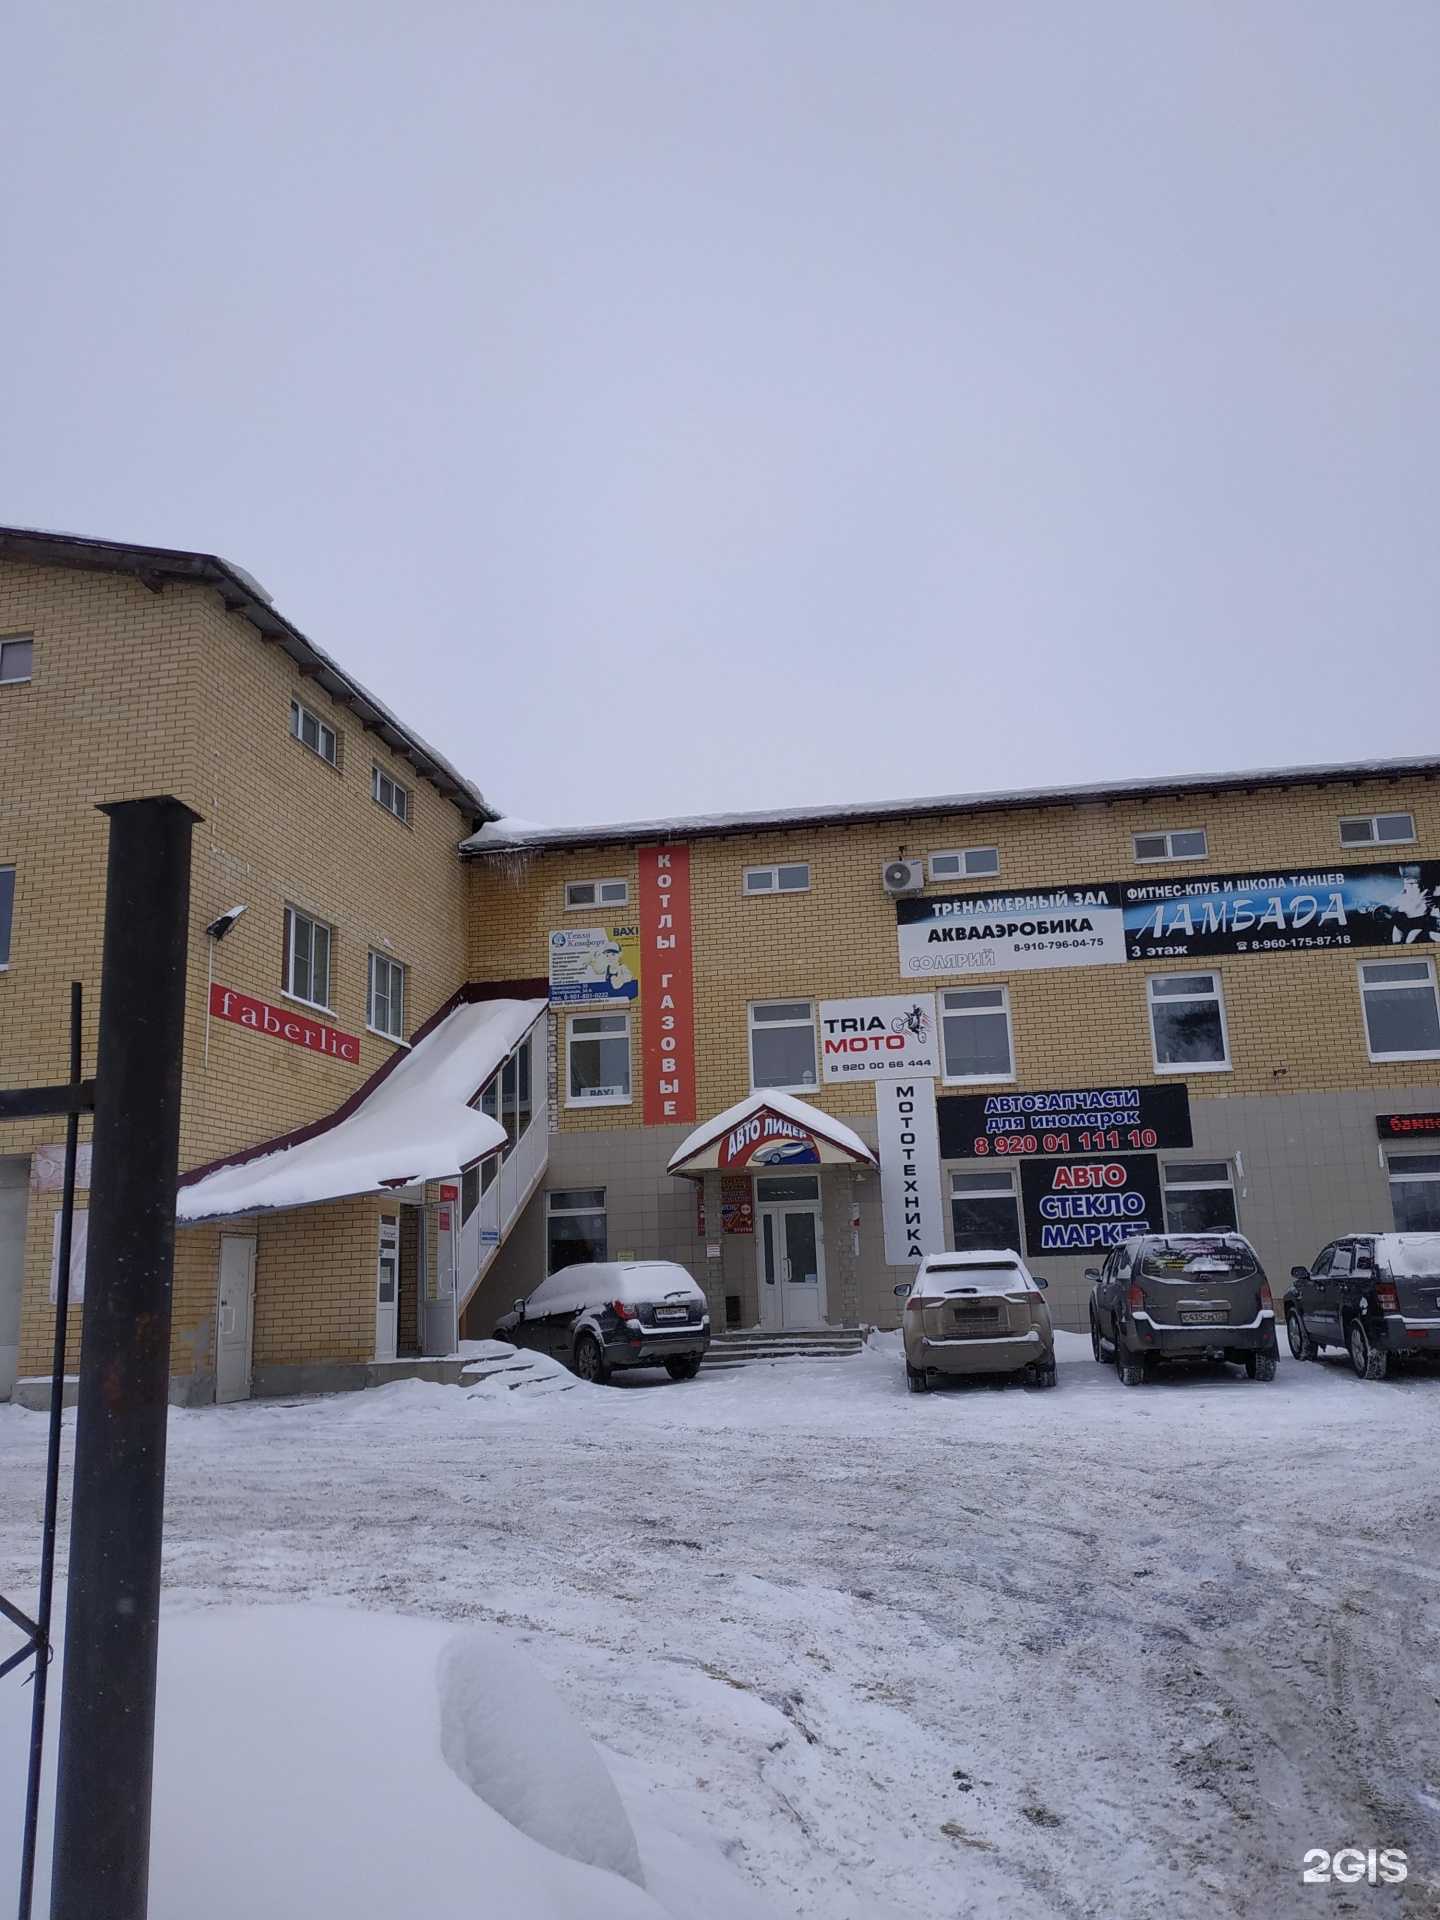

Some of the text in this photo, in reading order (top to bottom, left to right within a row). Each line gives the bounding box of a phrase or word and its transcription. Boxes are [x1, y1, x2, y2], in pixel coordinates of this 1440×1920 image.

[1127, 873, 1345, 900] ФИТНЕС-КЛУБ И ШКОЛА ТАНЦЕВ
[932, 890, 1109, 917] ТРЕНАЖЕРНЫЙ ЗАЛ
[613, 927, 639, 937] BAXI
[927, 918, 1094, 943] АКВААЭРОБИКА
[1251, 934, 1351, 950] 8-960-175-87-18
[1014, 937, 1104, 952] 8-910-796-04-75
[1131, 944, 1188, 957] 3 этаж
[909, 949, 997, 971] СОЛЯРИЙ
[656, 854, 679, 1115] КОТЛЫ ГАЗОВЫЕ
[221, 992, 353, 1059] faberlic
[824, 1016, 886, 1034] TRIA
[825, 1035, 905, 1054] MOTO
[842, 1063, 865, 1071] 920
[907, 1059, 931, 1067] 444
[984, 1089, 1140, 1114] АВТОЗАПЧАСТИ
[986, 1110, 1141, 1134] для иномарок
[727, 1119, 761, 1163] АВТО
[974, 1128, 1158, 1156] 8 920 01 111 10
[896, 1086, 923, 1257] МОТОТЕХНИКА
[1052, 1163, 1127, 1190] АВТО
[1039, 1191, 1146, 1219] СТЕКЛО
